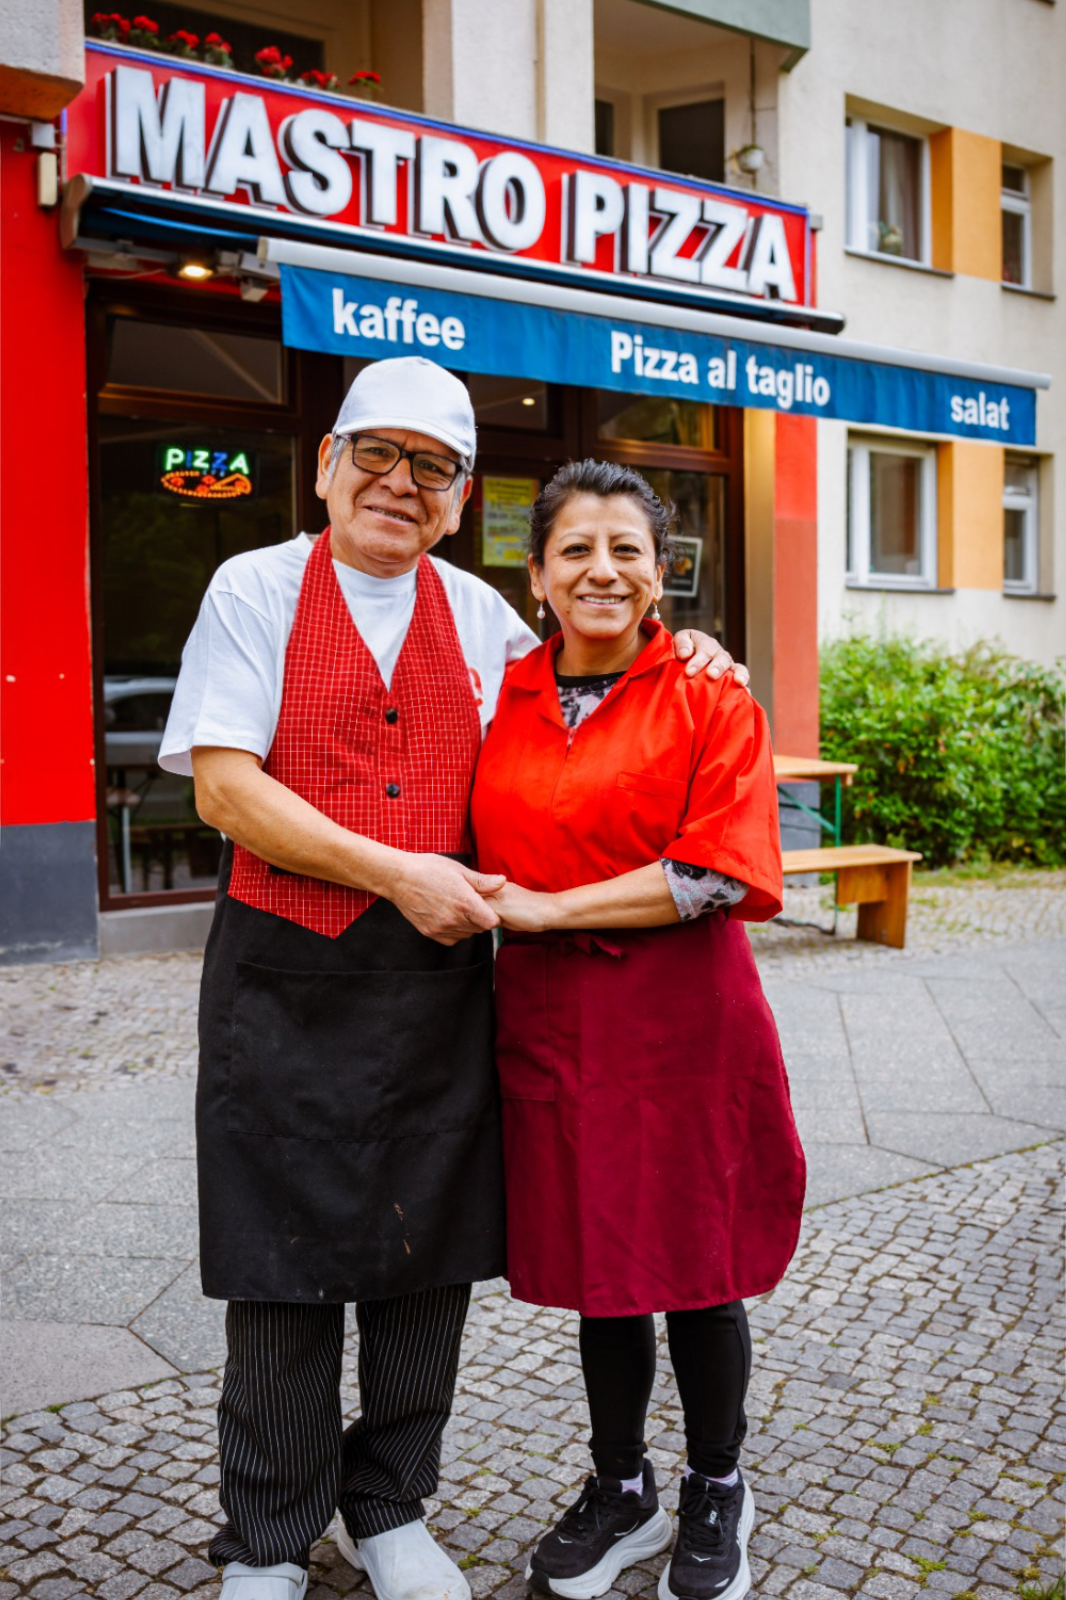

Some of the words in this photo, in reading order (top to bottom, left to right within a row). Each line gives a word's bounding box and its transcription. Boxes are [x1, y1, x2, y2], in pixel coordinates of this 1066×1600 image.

[105, 65, 547, 252] MASTRO
[562, 169, 797, 303] PIZZA
[332, 288, 466, 350] kaffee
[610, 332, 699, 385] Pizza
[707, 350, 737, 390] al
[745, 356, 831, 409] taglio
[950, 391, 1011, 431] salat
[164, 447, 251, 475] PIZZA
